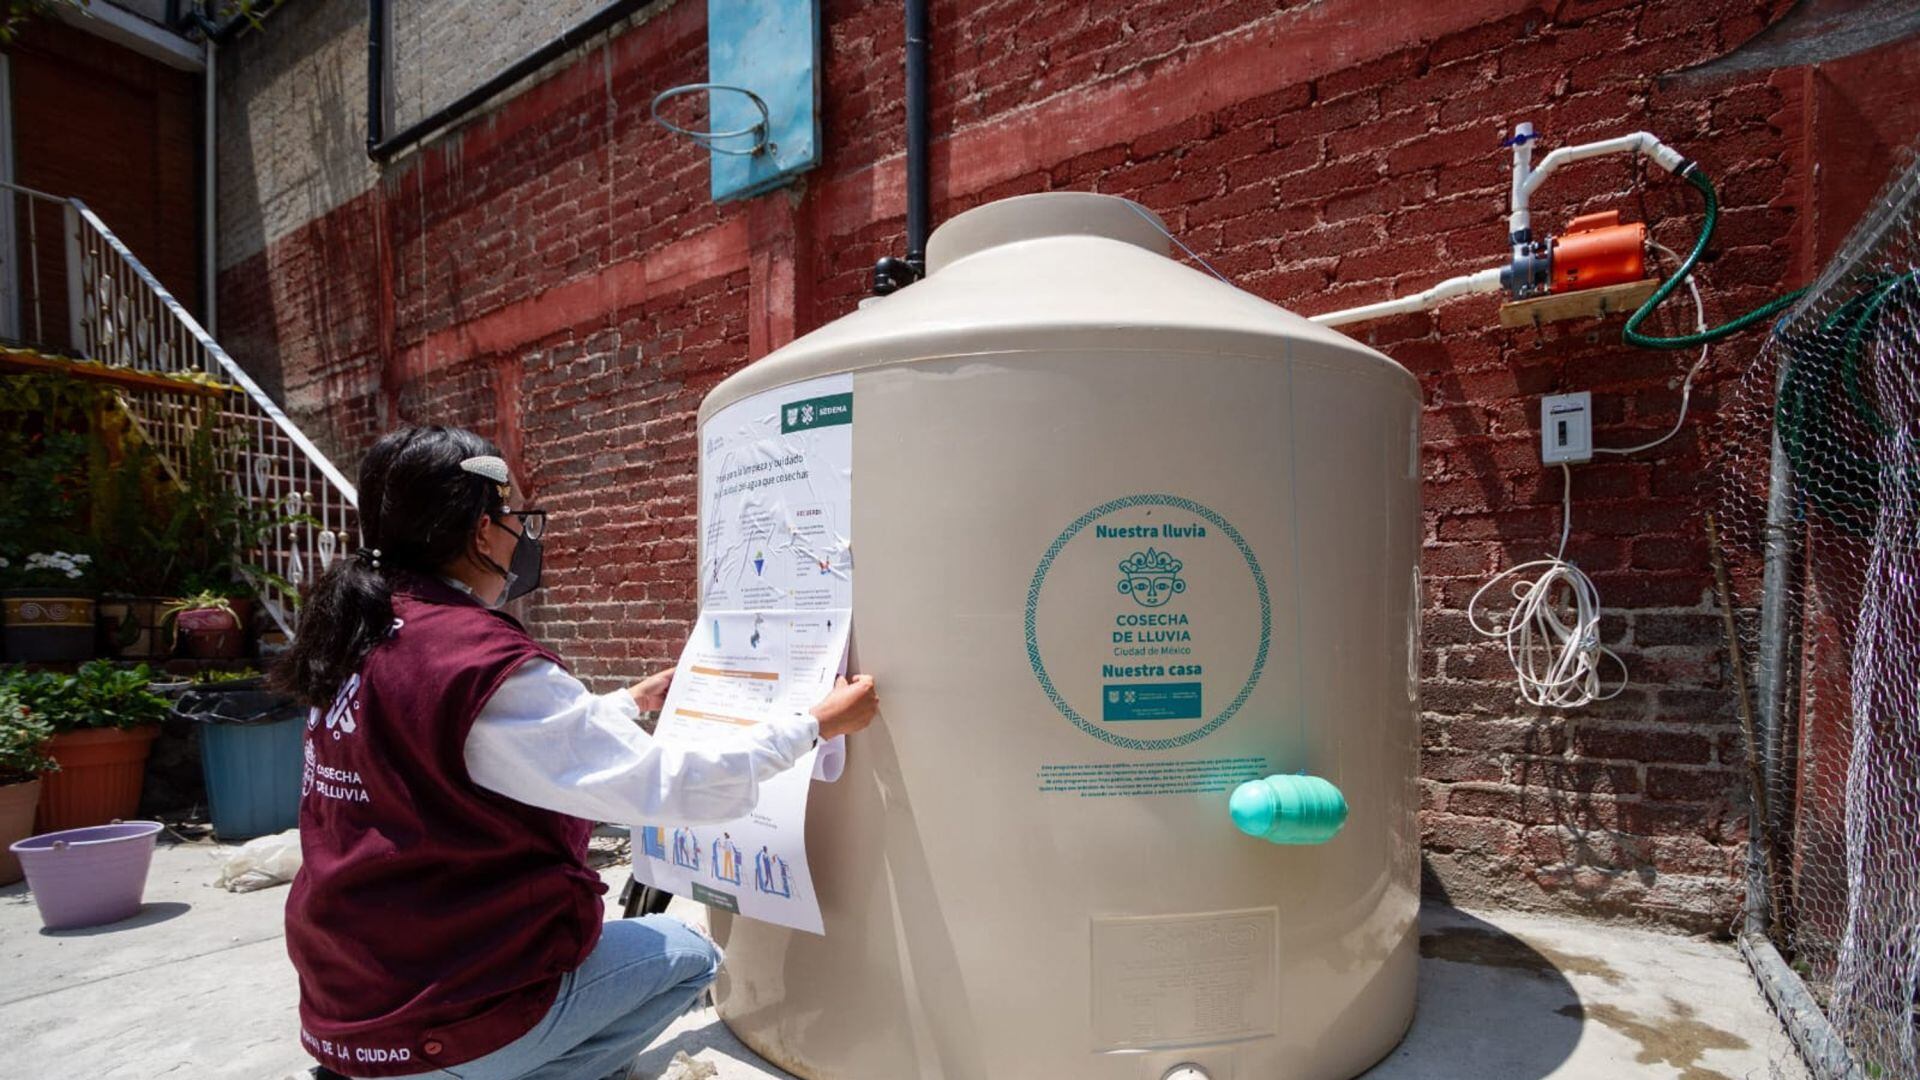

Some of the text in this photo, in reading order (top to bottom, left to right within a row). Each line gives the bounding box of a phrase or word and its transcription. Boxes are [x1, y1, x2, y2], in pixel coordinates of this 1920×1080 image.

[819, 405, 847, 416] SEDEMA
[1096, 523, 1206, 538] Nuestra lluvia
[1116, 614, 1189, 626] COSECHA
[1113, 630, 1191, 643] DE LLUVIA
[1114, 645, 1191, 656] Ciudad de México
[1103, 664, 1202, 678] Nuestra casa
[322, 1040, 334, 1055] DE
[337, 1043, 350, 1060] LA
[356, 1047, 410, 1062] CIUDAD
